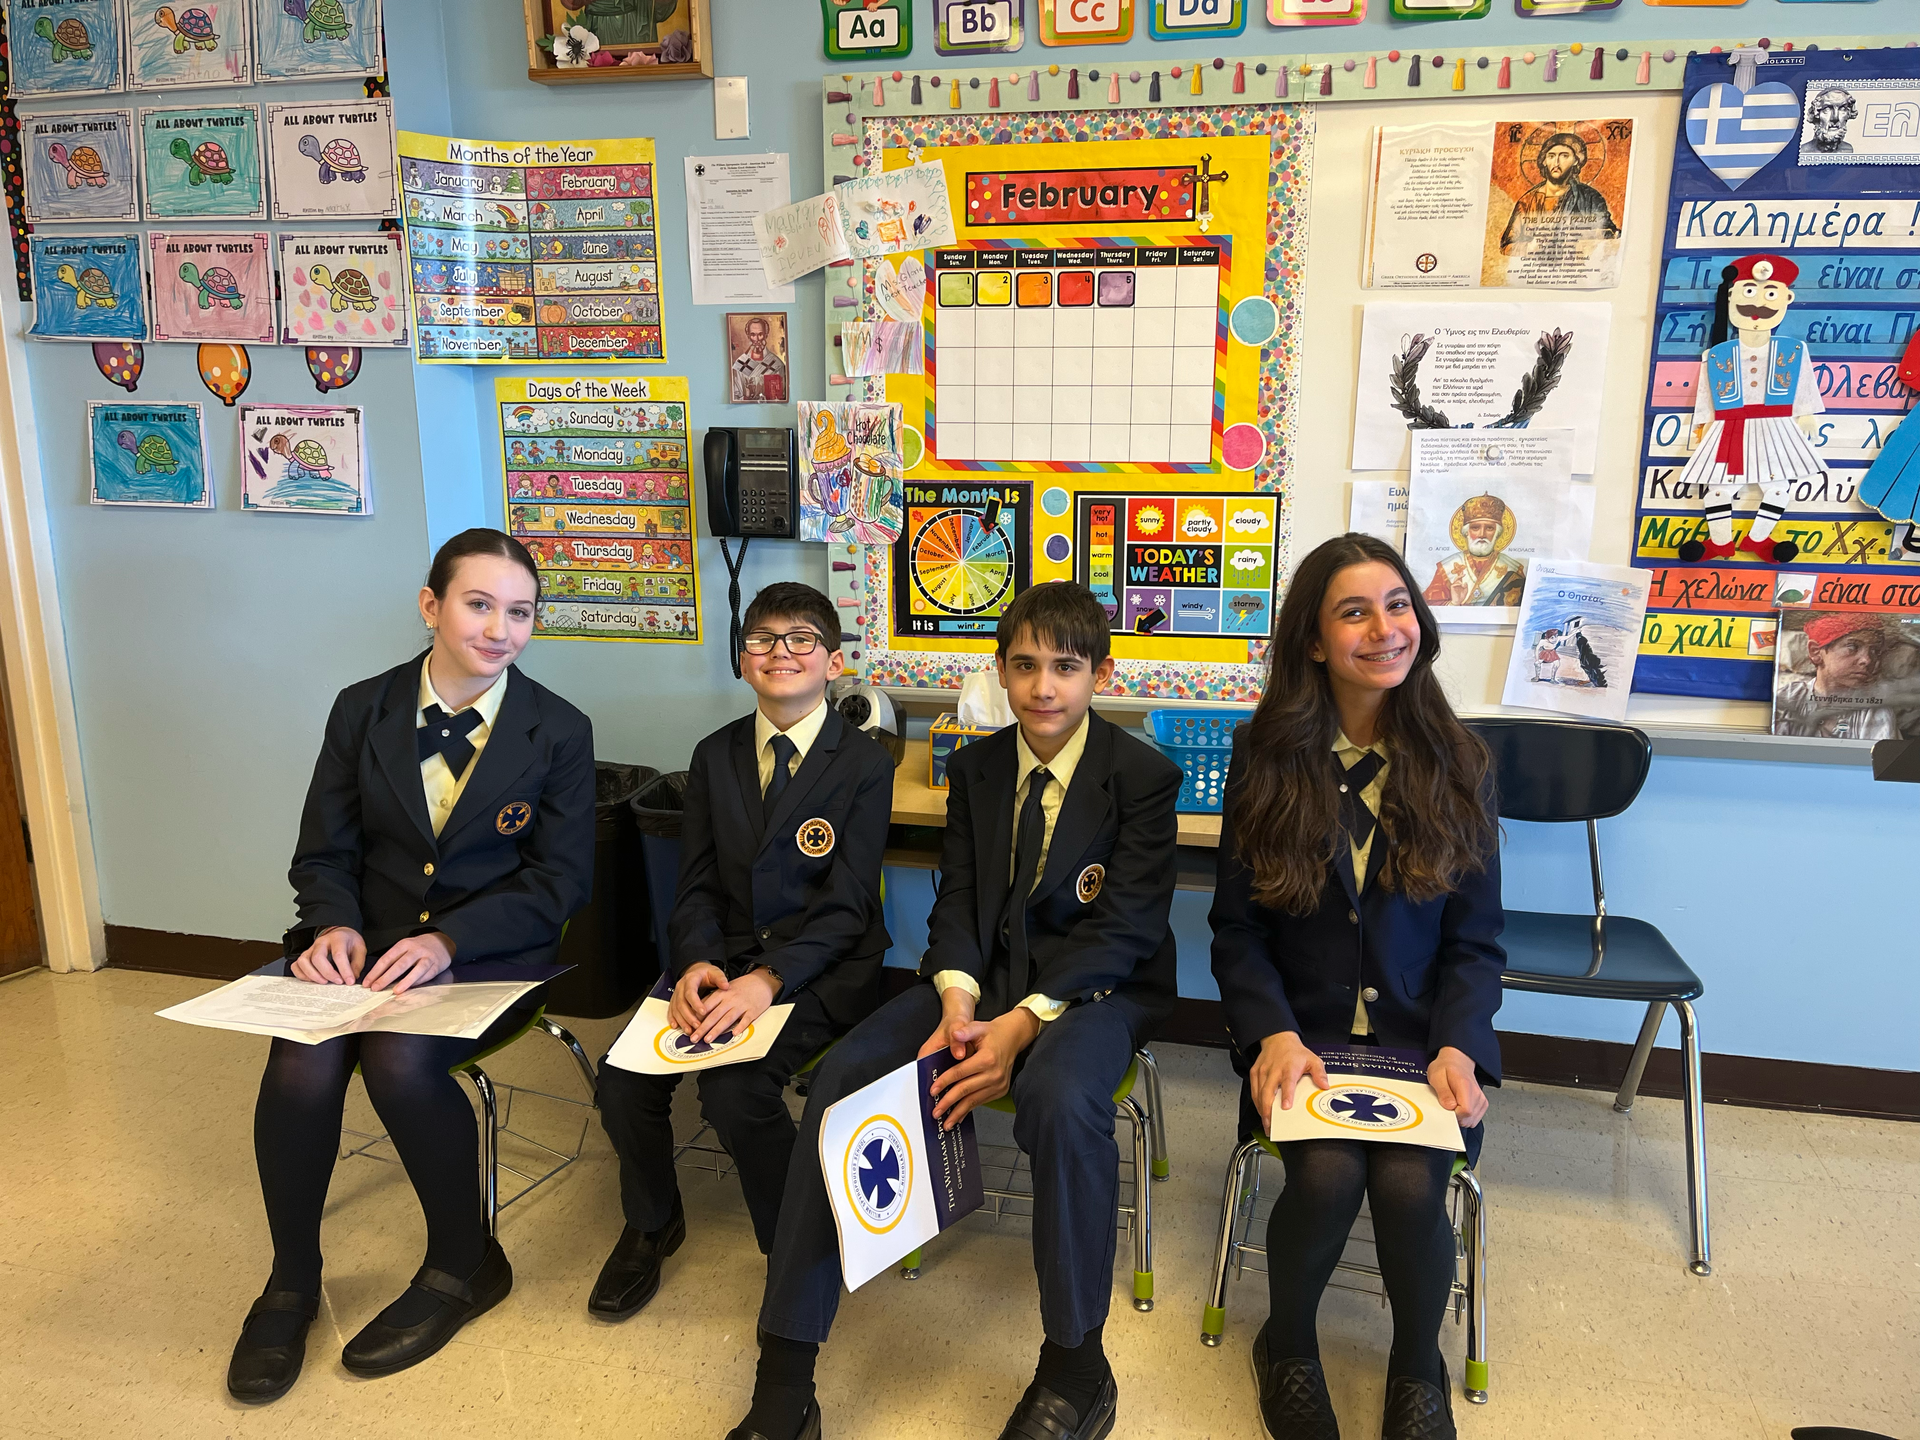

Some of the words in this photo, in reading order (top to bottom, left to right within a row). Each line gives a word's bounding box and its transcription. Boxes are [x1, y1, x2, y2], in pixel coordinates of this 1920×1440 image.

[849, 14, 885, 40] Aa
[962, 8, 996, 34] Bb
[155, 118, 171, 129] ALL
[173, 118, 203, 129] ABOUT
[206, 117, 245, 128] TURTLES
[284, 115, 300, 126] ALL
[302, 114, 335, 126] ABOUT
[337, 112, 379, 124] TURTLES
[35, 124, 49, 135] ALL
[51, 123, 79, 134] ABOUT
[81, 122, 117, 132] TURTLES
[449, 144, 509, 163] Months
[513, 147, 531, 165] of
[535, 148, 559, 163] the
[560, 146, 594, 163] Year
[434, 171, 484, 190] January
[562, 175, 617, 191] February
[1001, 181, 1159, 214] February
[442, 207, 483, 222] March
[576, 208, 604, 223] April
[1685, 200, 1886, 248] Καλημέρα
[44, 245, 59, 255] ALL
[61, 245, 87, 255] ABOUT
[90, 244, 127, 255] TURTLES
[166, 243, 182, 253] ALL
[184, 243, 213, 254] ABOUT
[215, 243, 254, 253] TURTLES
[295, 244, 311, 255] ALL
[314, 244, 345, 255] ABOUT
[349, 244, 389, 255] TURTLES
[451, 239, 478, 256] May
[582, 241, 609, 254] June
[943, 253, 967, 262] Sunday
[982, 253, 1008, 261] Monday
[1021, 252, 1048, 260] Tuesday
[1057, 251, 1094, 260] Wednesday
[1100, 251, 1131, 259] Thursday
[1145, 250, 1168, 259] Friday
[1183, 249, 1215, 258] Saturday
[453, 268, 477, 285] July
[574, 269, 614, 285] August
[1002, 275, 1008, 284] 2
[1043, 275, 1049, 285] 3
[1084, 275, 1091, 284] 4
[1126, 275, 1132, 285] 5
[1687, 257, 1713, 289] Τι
[1818, 258, 1883, 290] είναι
[439, 303, 504, 320] September
[572, 304, 623, 318] October
[1806, 315, 1873, 343] είναι
[441, 337, 502, 352] November
[570, 336, 628, 350] December
[528, 382, 562, 400] Days
[565, 381, 582, 398] of
[584, 382, 607, 398] the
[610, 381, 647, 398] Week
[104, 412, 119, 422] ALL
[121, 412, 149, 422] ABOUT
[151, 413, 187, 423] TURTLES
[256, 415, 272, 426] ALL
[274, 416, 305, 427] ABOUT
[307, 417, 345, 427] TURTLES
[569, 410, 614, 428] Sunday
[572, 447, 623, 465] Monday
[570, 477, 623, 494] Tuesday
[904, 487, 936, 503] The
[941, 487, 1000, 504] Month
[1004, 488, 1020, 504] Is
[566, 511, 636, 530] Wednesday
[1093, 509, 1111, 517] very
[1096, 514, 1108, 522] hot
[1139, 516, 1161, 525] sunny
[1188, 519, 1211, 528] partly
[1235, 517, 1261, 525] cloudy
[948, 517, 960, 550] December
[964, 518, 975, 544] January
[1187, 525, 1213, 534] cloudy
[929, 528, 955, 554] November
[573, 542, 633, 560] Thursday
[919, 547, 944, 559] October
[985, 549, 1005, 558] March
[1134, 547, 1215, 565] TODAY'S
[1238, 555, 1258, 564] rainy
[919, 563, 951, 576] September
[989, 568, 1005, 577] April
[1129, 566, 1218, 583] WEATHER
[583, 577, 622, 595] Friday
[930, 577, 948, 595] August
[983, 583, 995, 597] May
[1671, 572, 1768, 608] χελώνα
[1818, 576, 1869, 604] είναι
[949, 593, 957, 606] July
[1234, 600, 1261, 609] stormy
[1568, 592, 1605, 605] Θησέας
[1181, 602, 1204, 611] windy
[580, 609, 637, 627] Saturday
[912, 620, 922, 631] It
[924, 619, 934, 631] is
[957, 622, 986, 630] winter
[1668, 617, 1735, 654] χαλί
[1809, 694, 1853, 704] Γεννήθηκα
[1865, 697, 1883, 705] 1821
